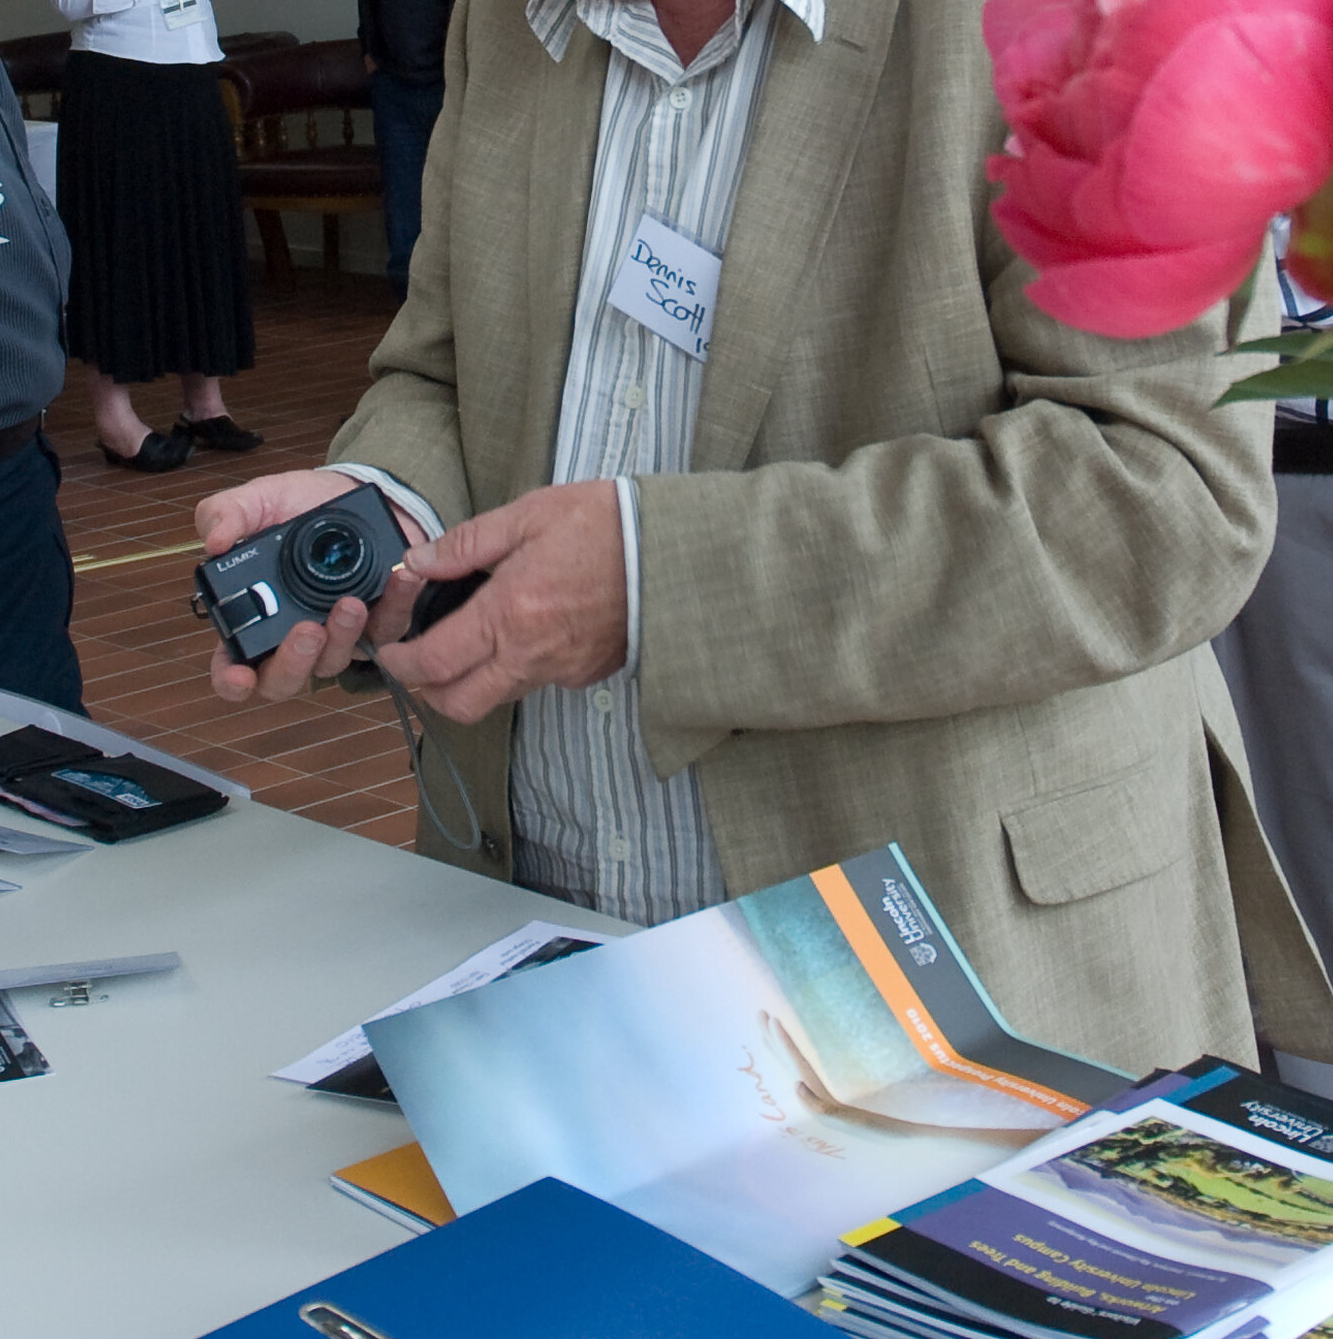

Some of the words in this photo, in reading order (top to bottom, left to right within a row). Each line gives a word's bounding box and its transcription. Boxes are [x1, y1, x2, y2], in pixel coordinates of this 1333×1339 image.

[631, 239, 697, 295] Dennis
[645, 278, 706, 335] Scott
[216, 547, 259, 573] LUMIX
[881, 877, 925, 942] University
[881, 895, 916, 945] Lincoln
[1239, 1099, 1324, 1140] University
[1247, 1114, 1313, 1144] Lincoln
[1012, 1234, 1070, 1264] Campus
[1068, 1259, 1143, 1289] University
